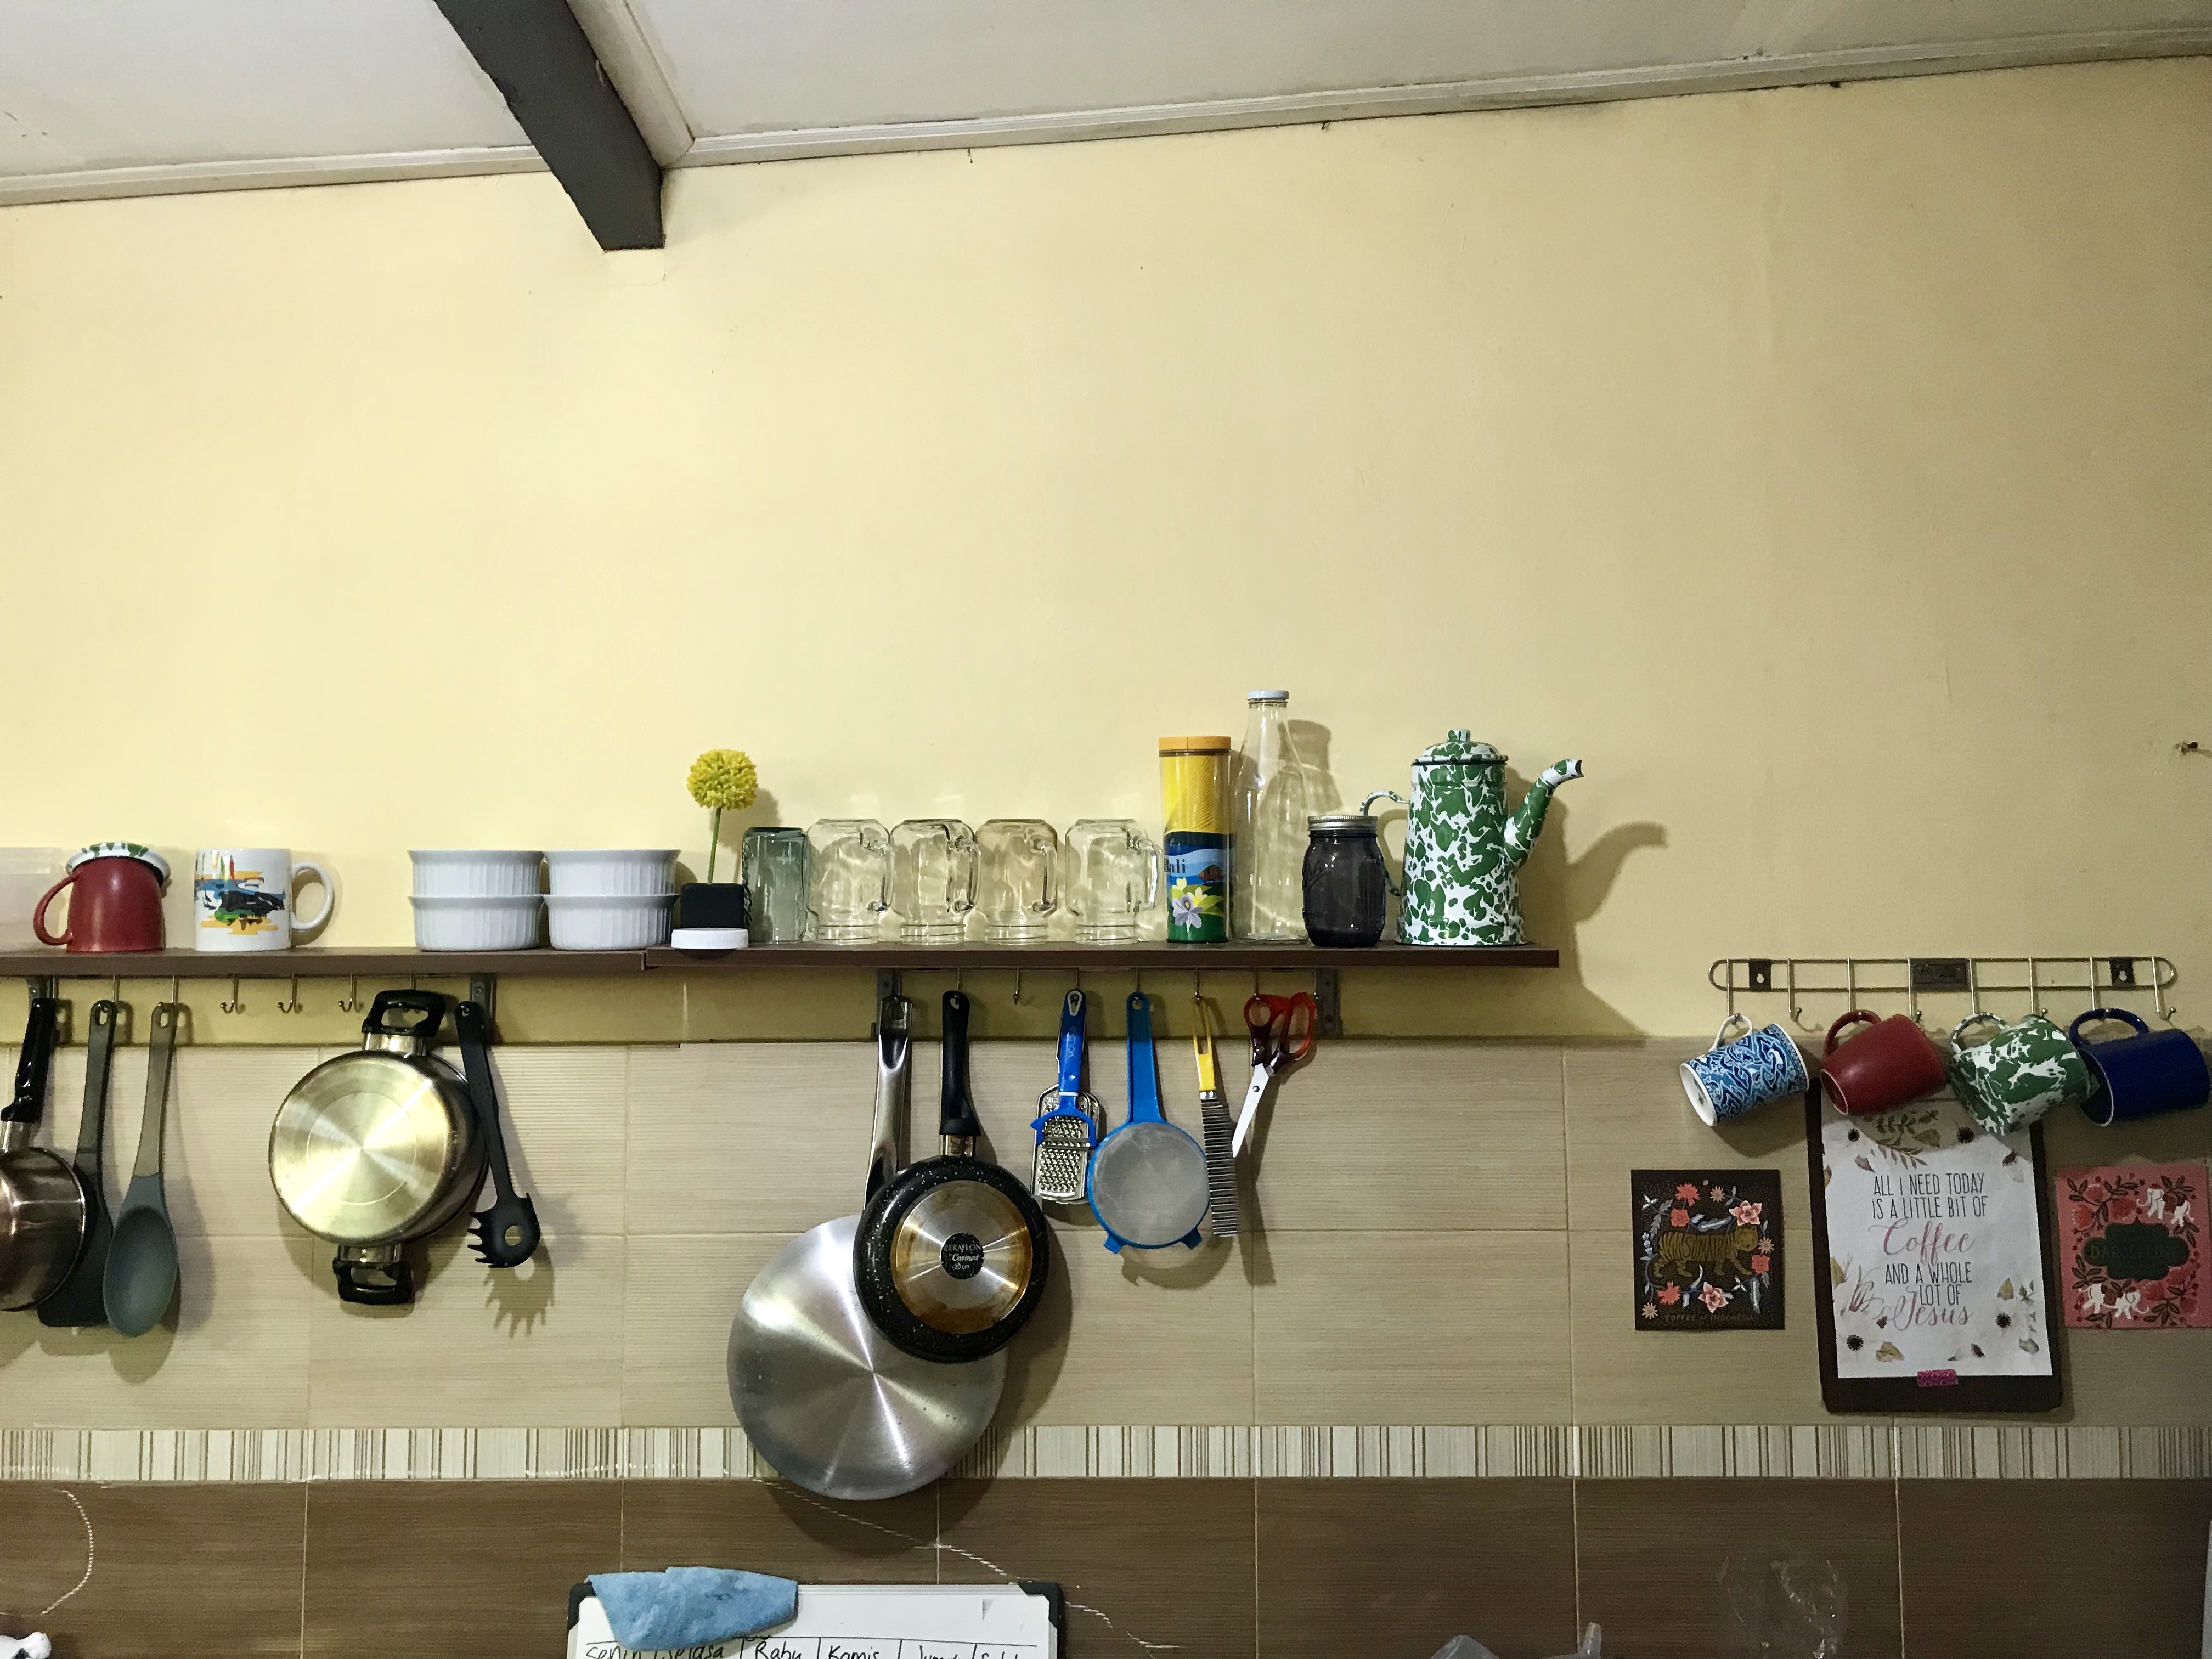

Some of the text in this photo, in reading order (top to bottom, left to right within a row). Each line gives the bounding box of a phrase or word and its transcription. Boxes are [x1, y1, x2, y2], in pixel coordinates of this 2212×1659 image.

[1164, 858, 1186, 874] Bali
[1874, 1172, 1984, 1196] ALL I NEED TODAY
[1872, 1195, 1988, 1219] IS A LITTLE BIT OF
[1867, 1218, 1975, 1266] Coffee
[1885, 1262, 1972, 1284] AND A WHOLE
[1920, 1284, 1962, 1306] LOT OF
[1879, 1286, 1974, 1331] Jesus
